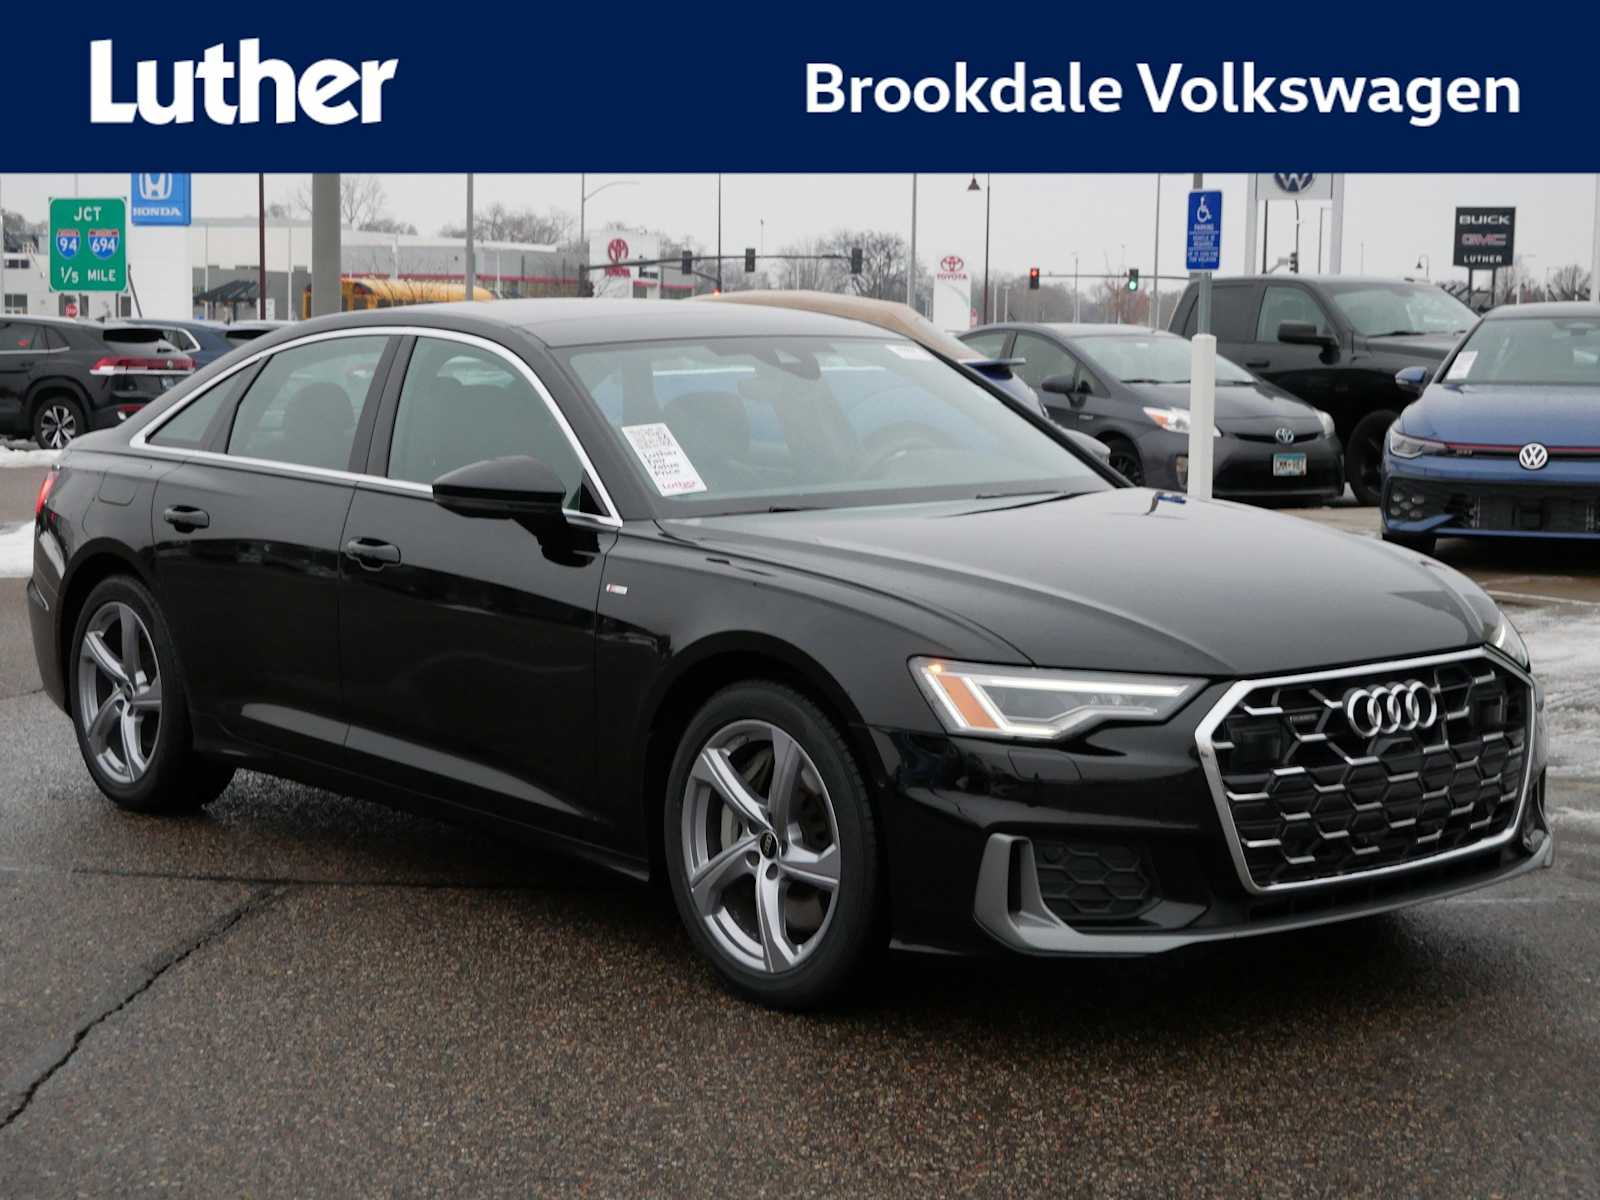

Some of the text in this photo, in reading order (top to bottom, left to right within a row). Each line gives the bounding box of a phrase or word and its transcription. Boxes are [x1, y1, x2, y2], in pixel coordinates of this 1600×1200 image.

[73, 206, 102, 221] JCT
[132, 206, 182, 217] HONDA
[1459, 215, 1511, 225] BUICK
[59, 238, 117, 253] 94 694
[1461, 233, 1507, 246] GMC
[1463, 254, 1503, 264] LUTHER
[60, 266, 117, 284] 1/5 MILE
[936, 273, 968, 281] TOYOTA
